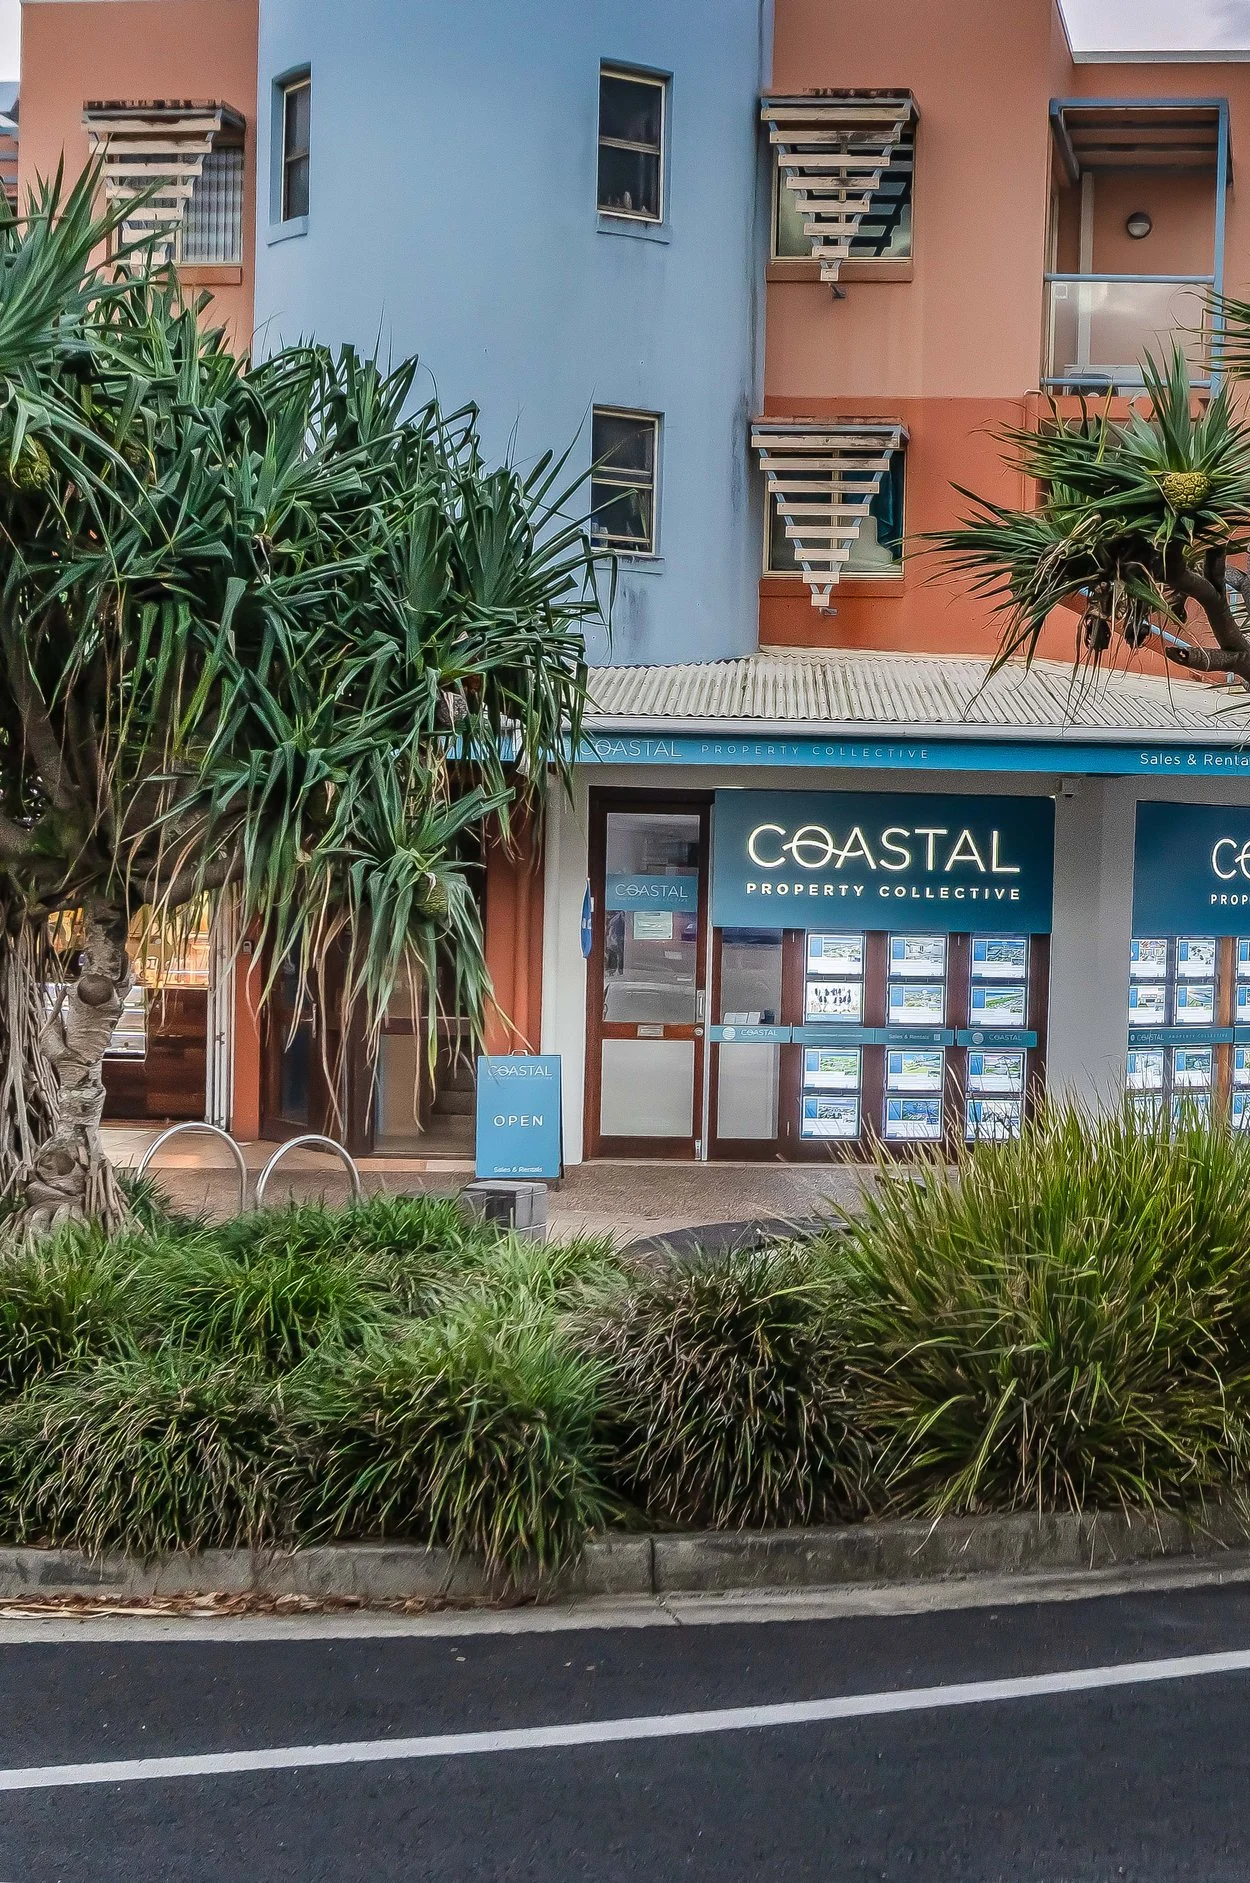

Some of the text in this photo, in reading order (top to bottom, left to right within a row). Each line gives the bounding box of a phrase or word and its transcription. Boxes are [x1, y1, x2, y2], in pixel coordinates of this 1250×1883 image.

[580, 739, 928, 759] COASTAL PROPERTY COLLECTIVE
[1140, 753, 1181, 765] Sales
[1187, 753, 1197, 765] &
[748, 823, 1021, 873] COASTAL
[615, 883, 689, 898] COASTAL
[746, 882, 1020, 900] PROPERTY COLLECTIVE
[1136, 1033, 1165, 1041] COASTAL
[487, 1065, 553, 1077] COASTAL
[493, 1115, 544, 1127] OPEN
